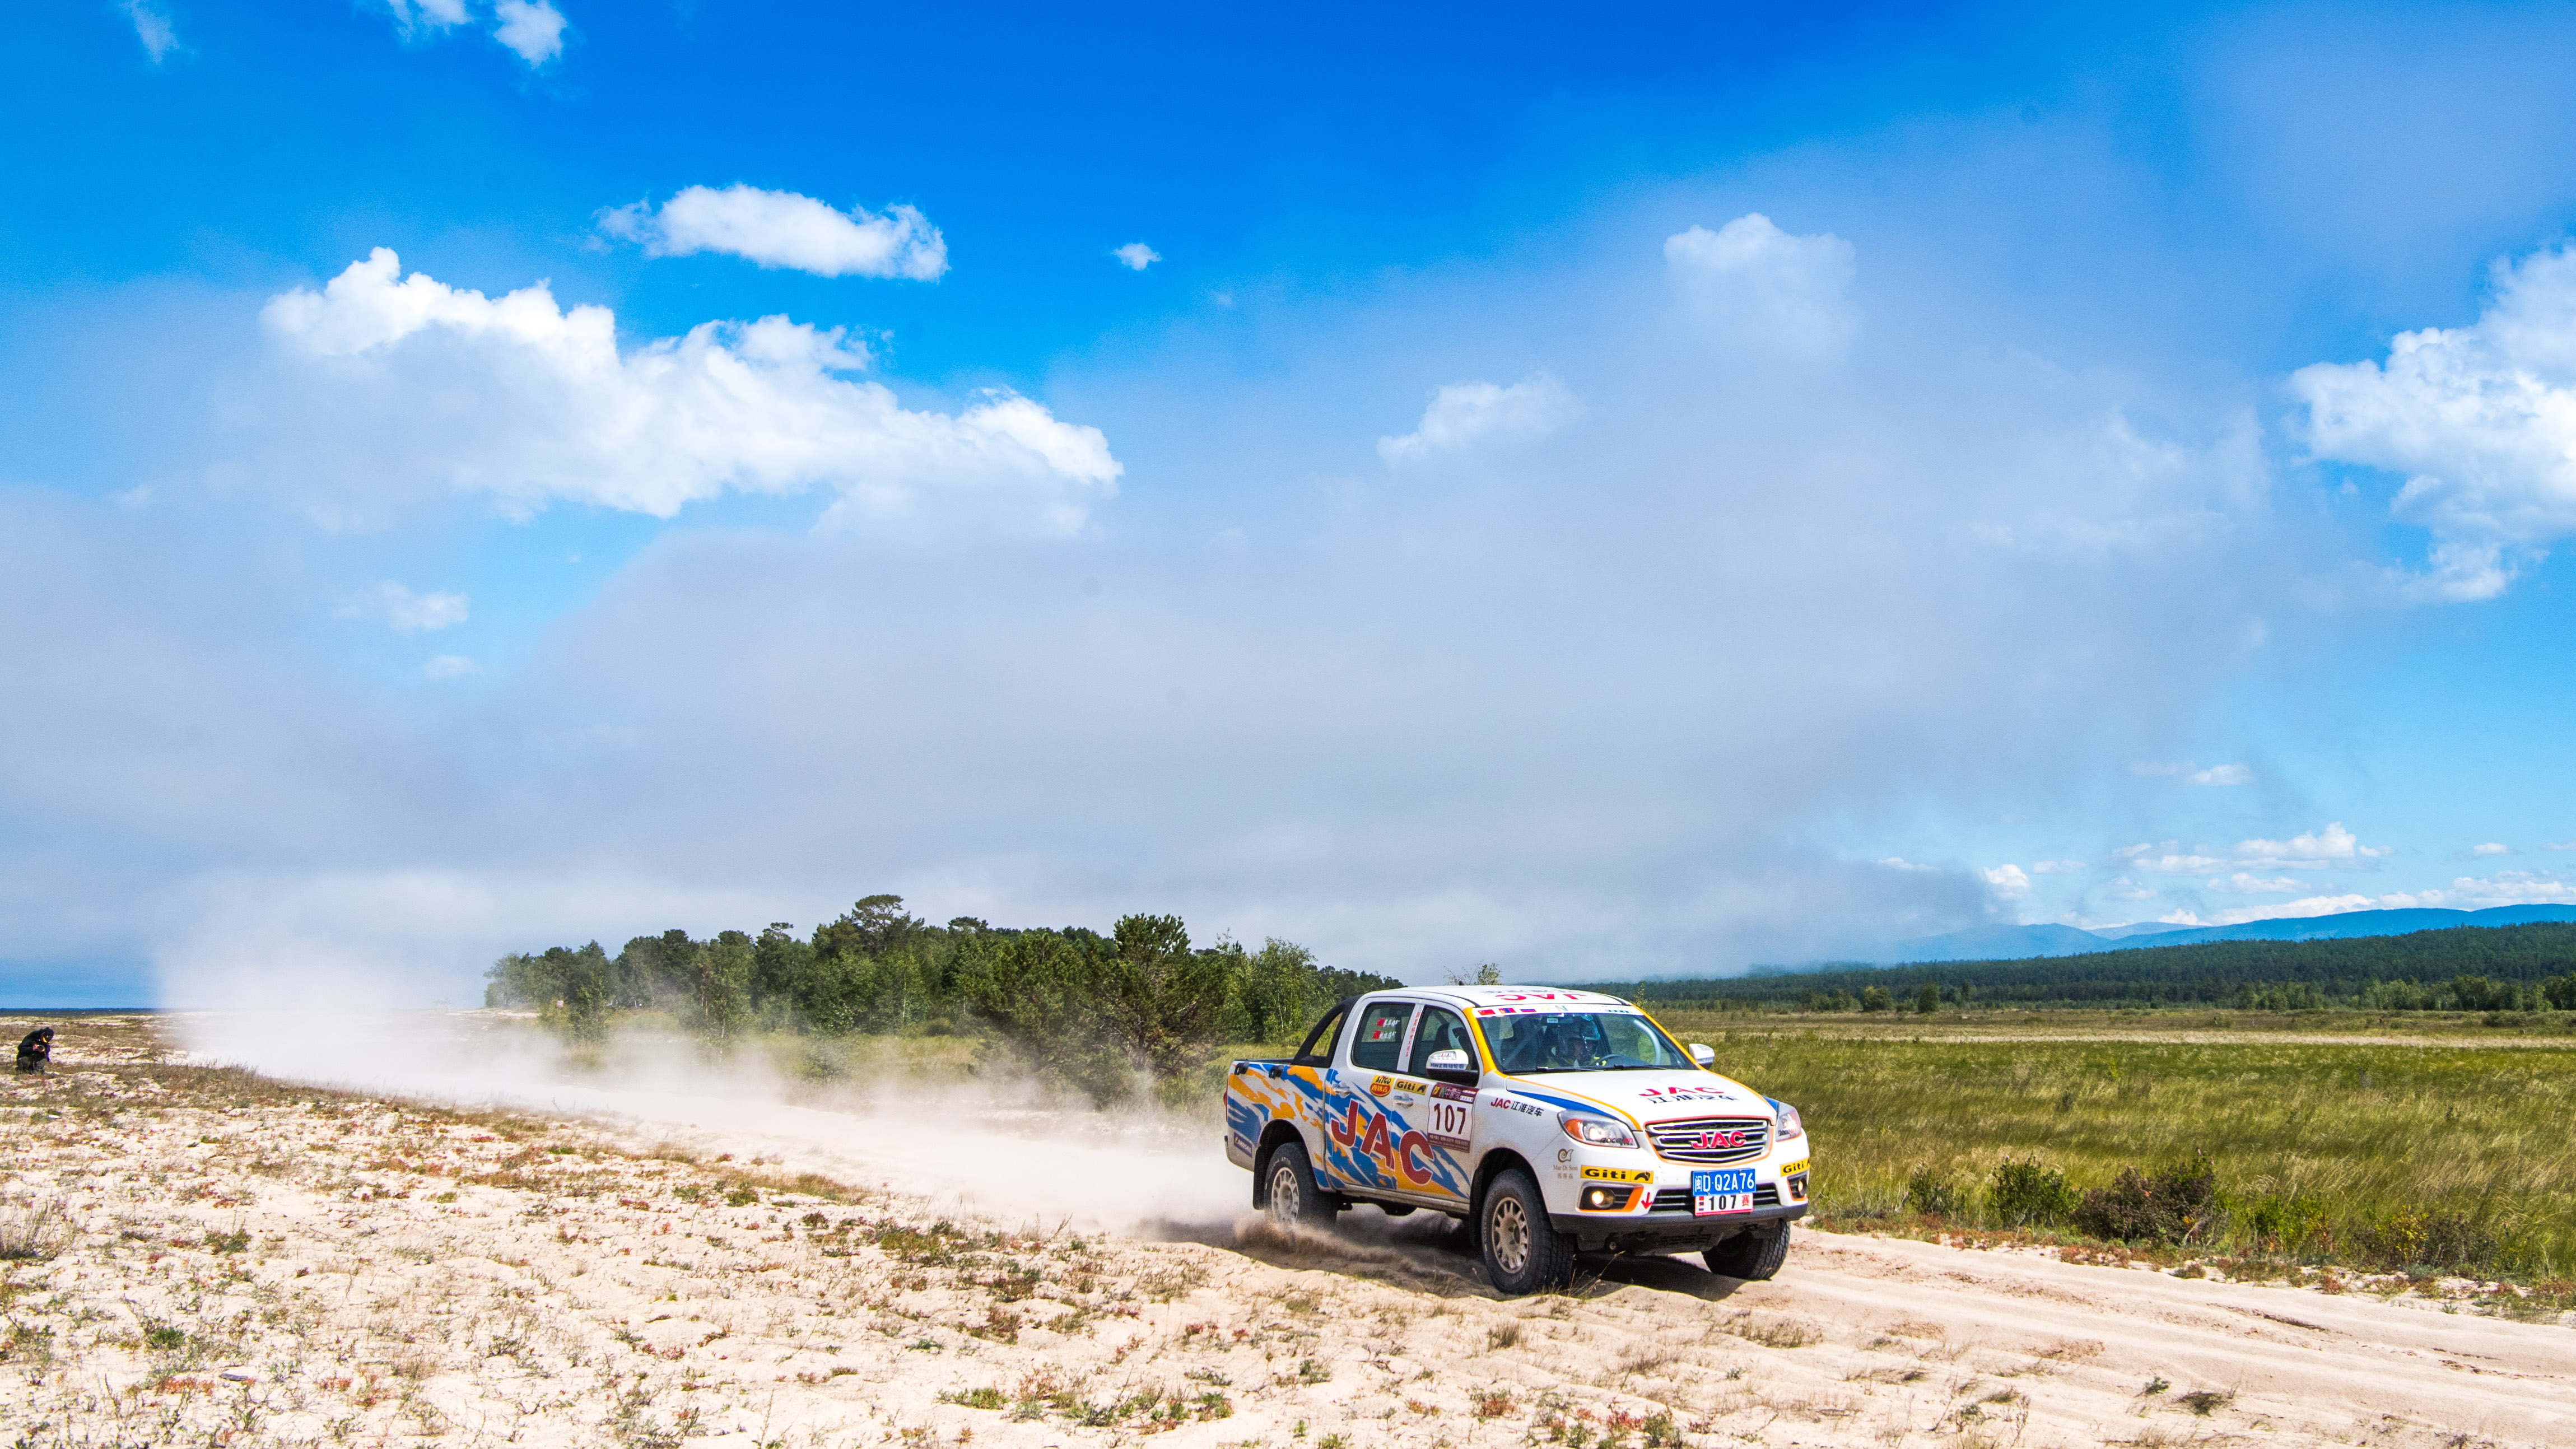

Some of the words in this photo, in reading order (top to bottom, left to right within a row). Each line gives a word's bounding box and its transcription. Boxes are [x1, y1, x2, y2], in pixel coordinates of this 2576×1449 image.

[1397, 1081, 1415, 1091] Giti
[1638, 1087, 1725, 1096] JAC
[1490, 1097, 1511, 1109] JAC
[1511, 1101, 1544, 1116] 江淮汽车
[1434, 1103, 1466, 1135] 107
[1330, 1099, 1434, 1186] JAC
[1691, 1131, 1746, 1149] JAC
[1585, 1168, 1626, 1180] Giti
[1783, 1161, 1804, 1173] Giti
[1709, 1195, 1736, 1210] 107
